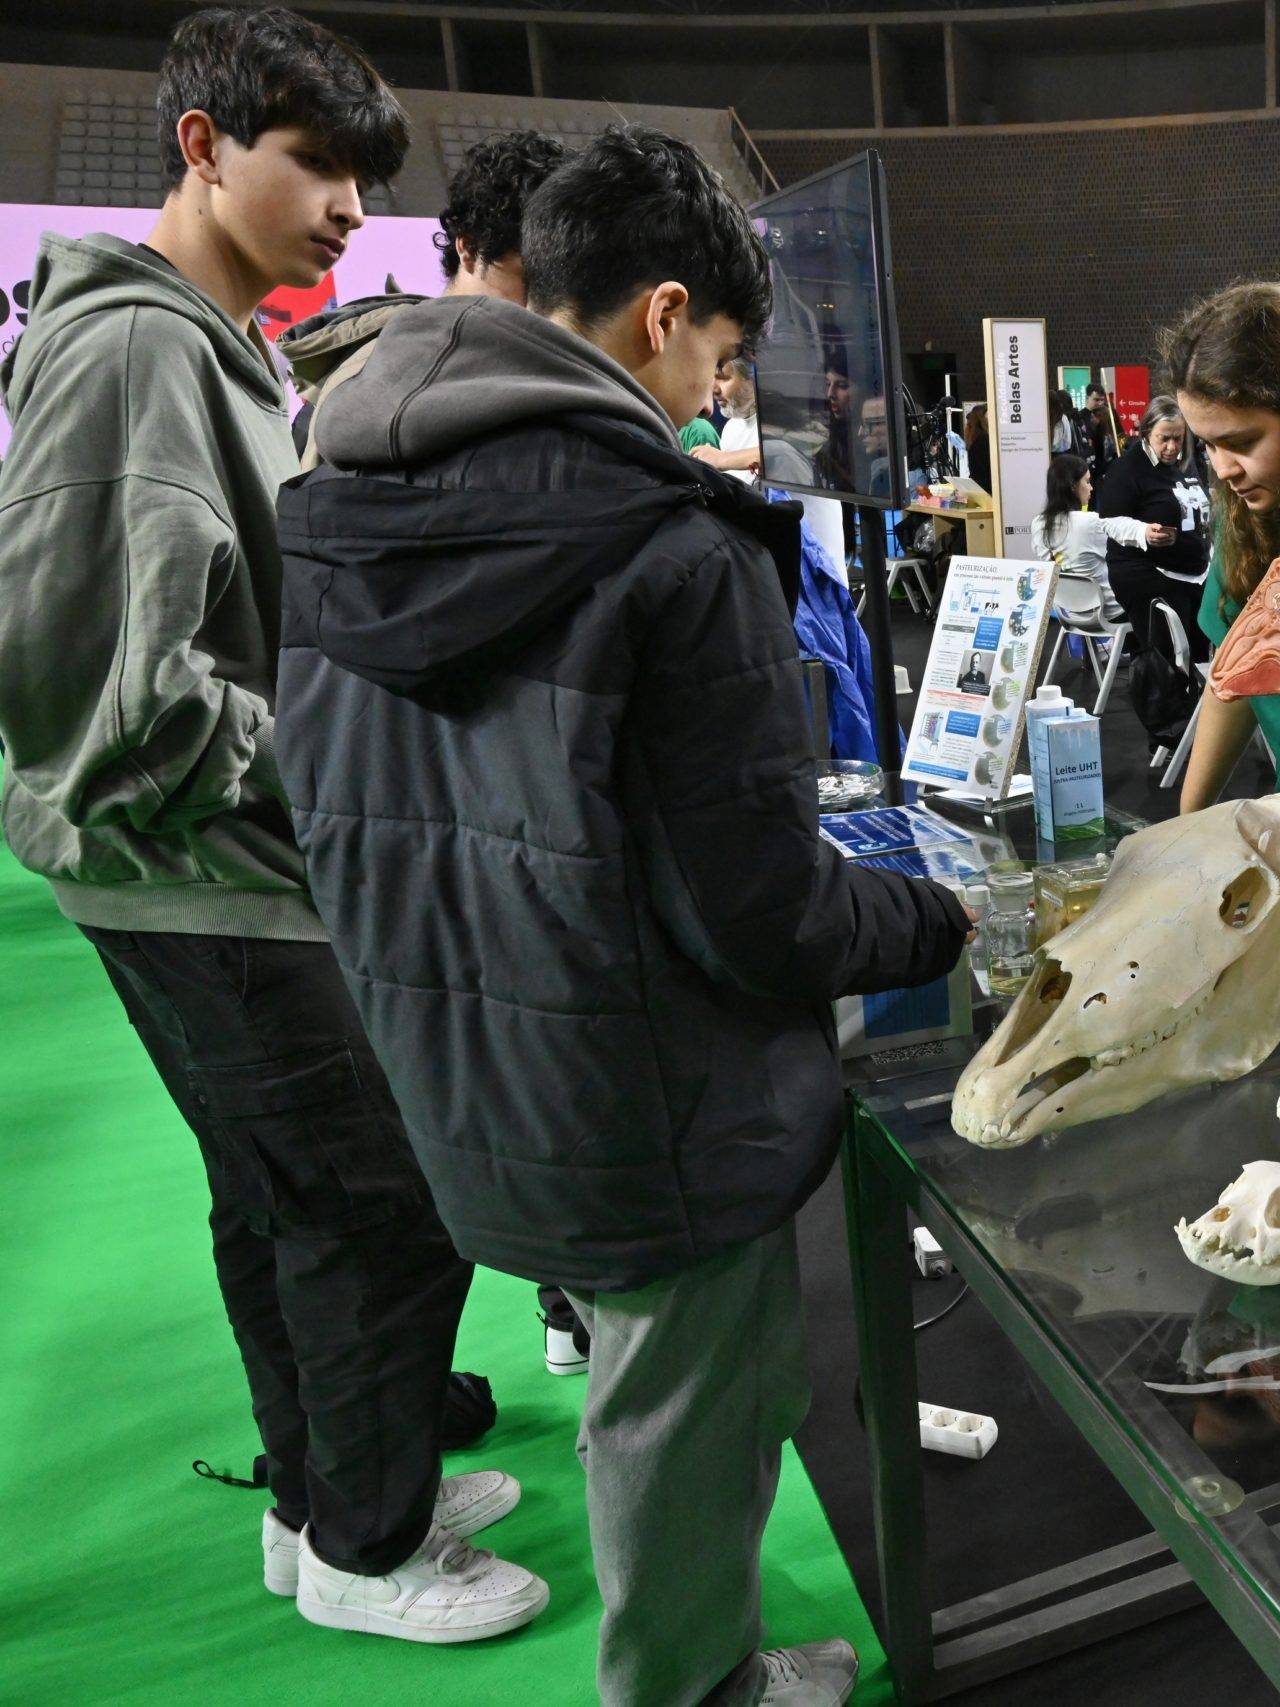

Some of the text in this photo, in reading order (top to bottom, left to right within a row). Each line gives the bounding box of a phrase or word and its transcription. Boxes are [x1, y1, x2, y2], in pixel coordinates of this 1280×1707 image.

[1008, 335, 1022, 424] Belas Artes
[1055, 761, 1098, 776] Leite UHT
